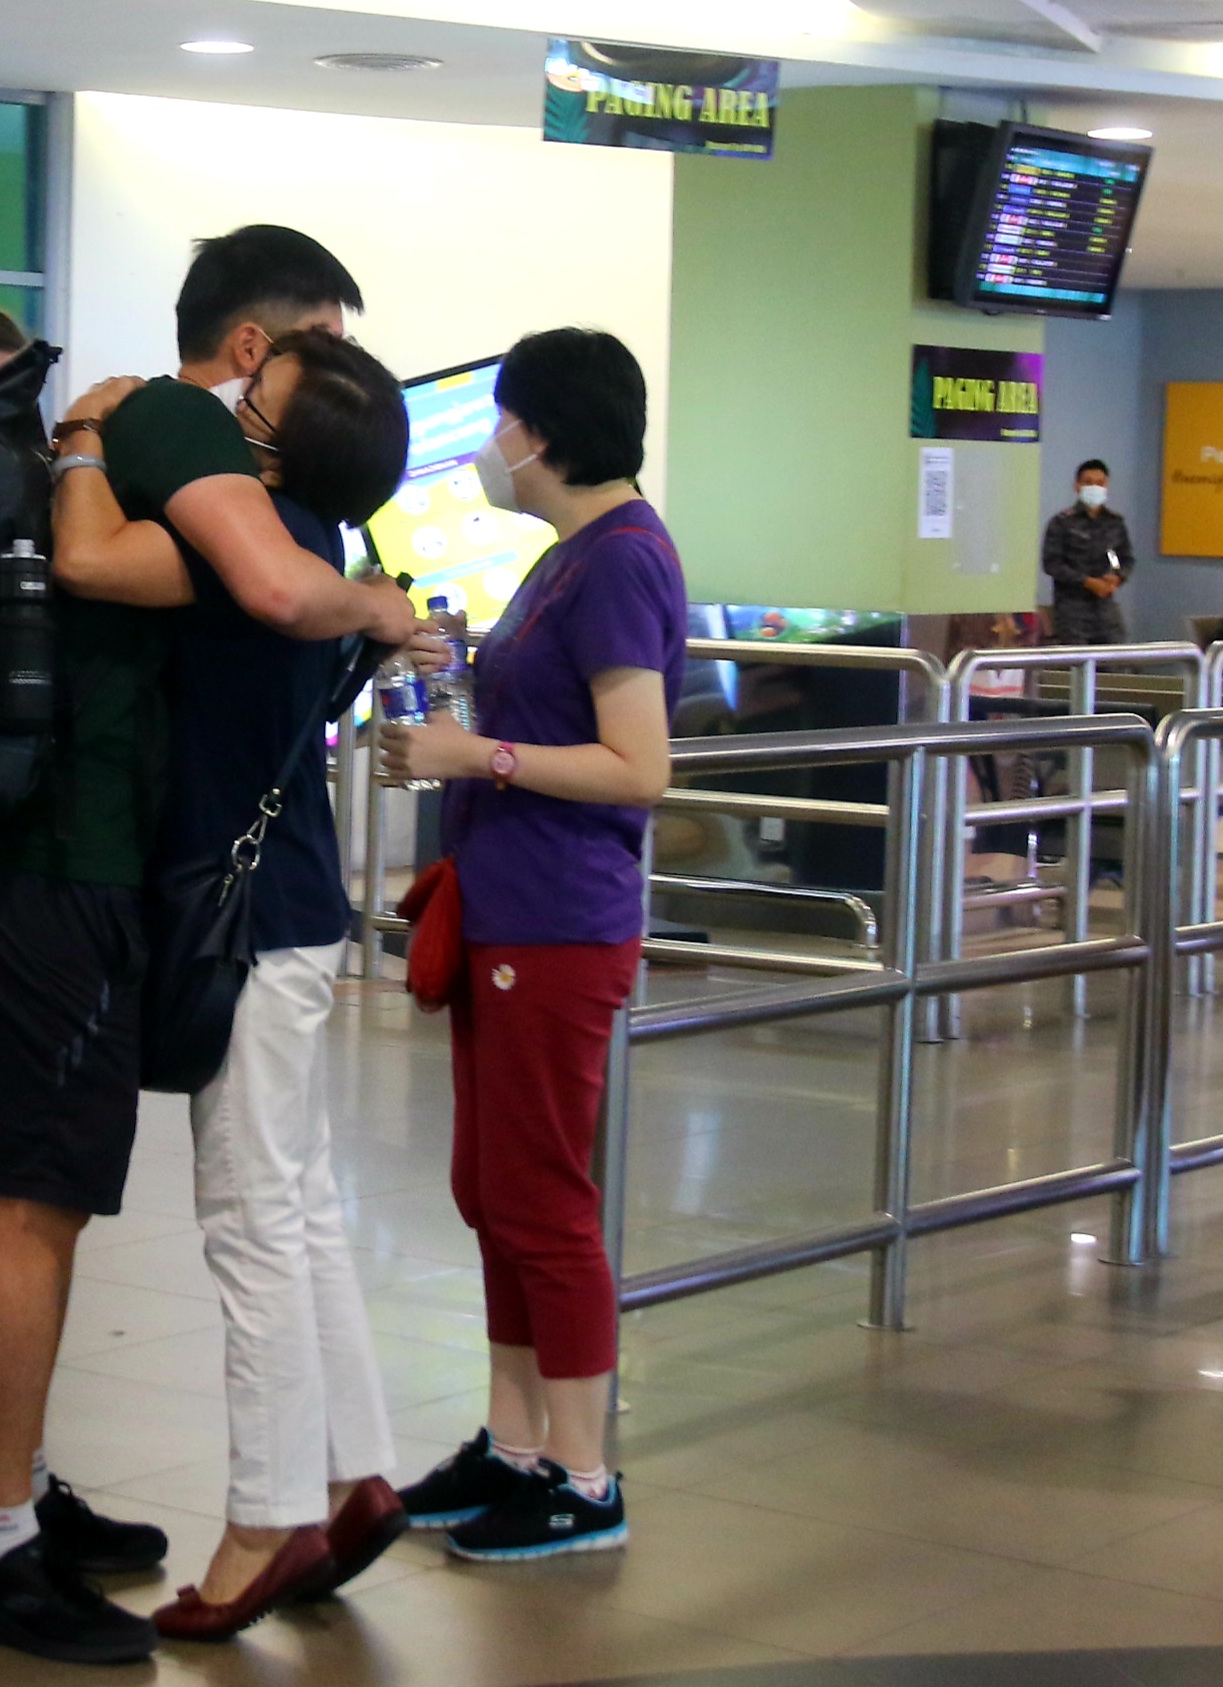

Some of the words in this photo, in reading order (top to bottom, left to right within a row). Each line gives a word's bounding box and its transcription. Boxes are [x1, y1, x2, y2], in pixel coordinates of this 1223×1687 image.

[585, 80, 694, 121] PAGING
[699, 87, 771, 128] AREA
[933, 376, 995, 412] PAGING
[997, 381, 1038, 414] AREA
